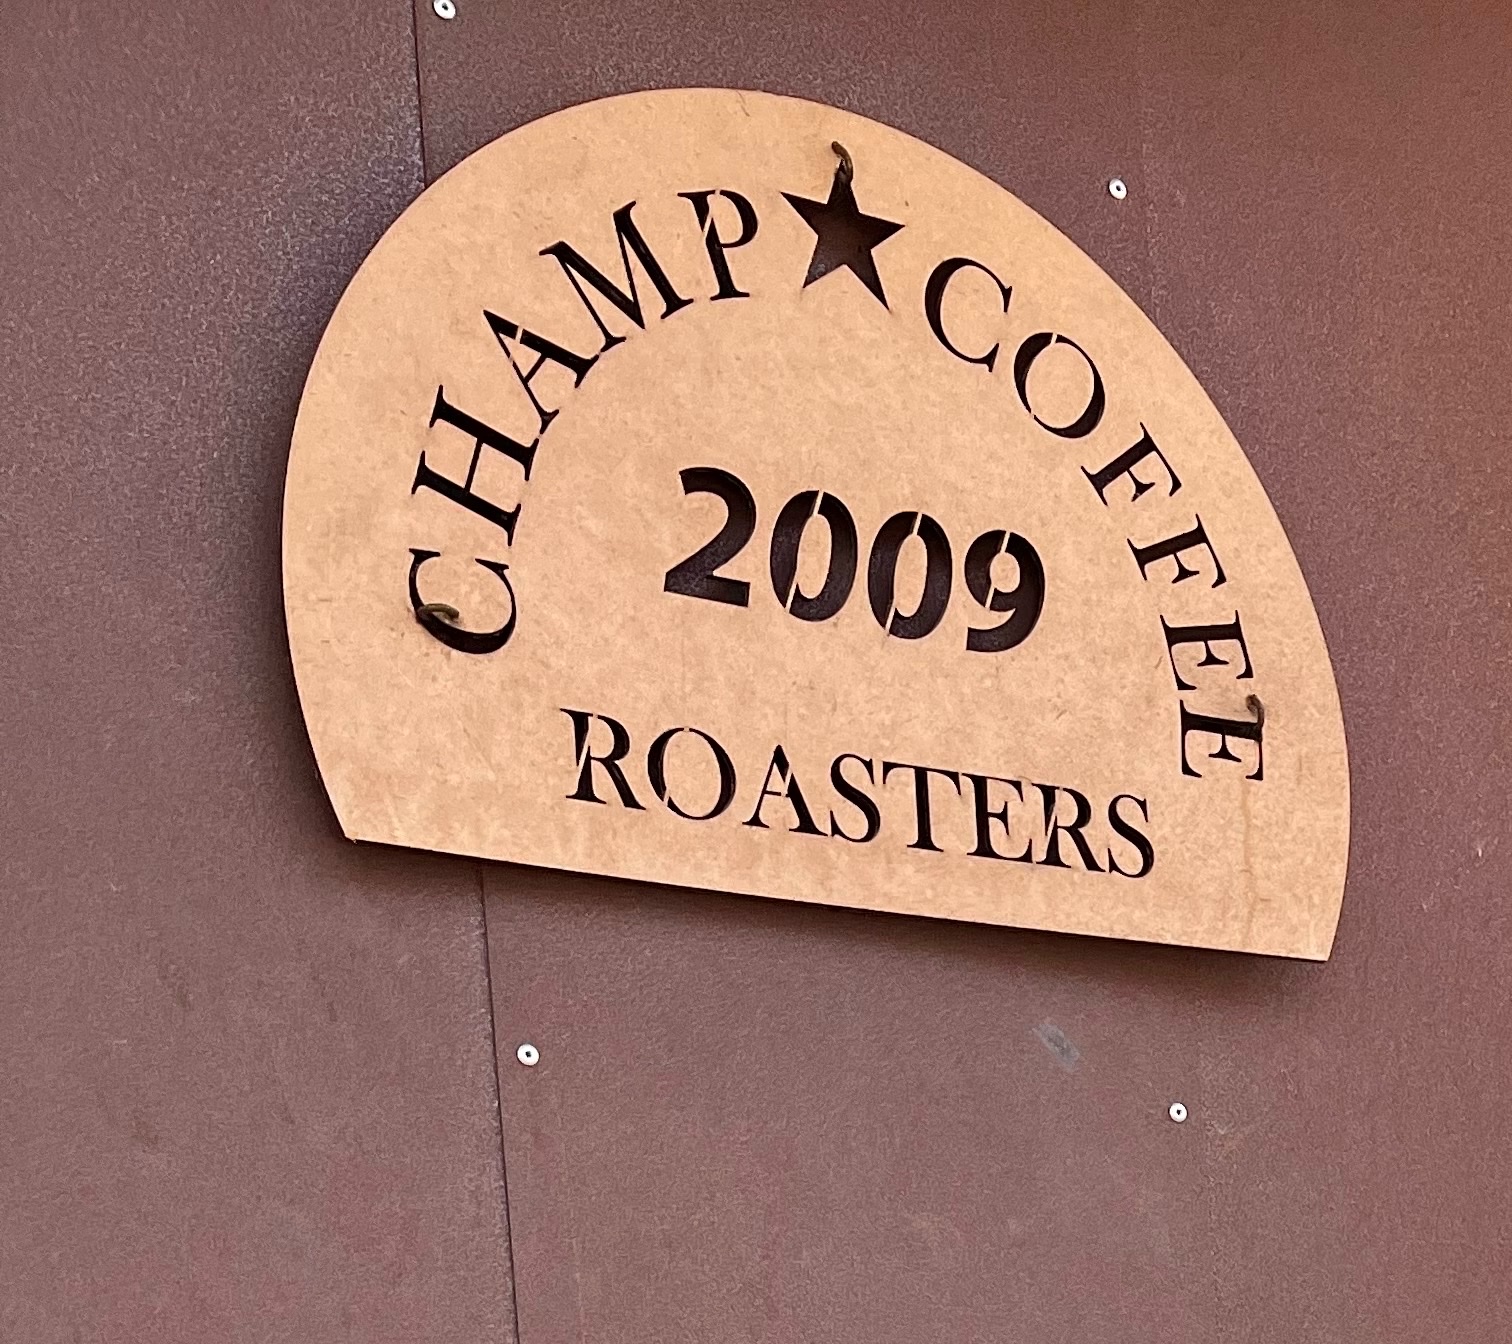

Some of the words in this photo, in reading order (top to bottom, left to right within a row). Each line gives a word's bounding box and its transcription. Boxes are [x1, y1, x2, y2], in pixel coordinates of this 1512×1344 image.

[409, 190, 758, 654] CHAMP
[925, 258, 1264, 781] COFFEE
[664, 467, 1045, 652] 2009
[560, 708, 1154, 878] ROASTERS
